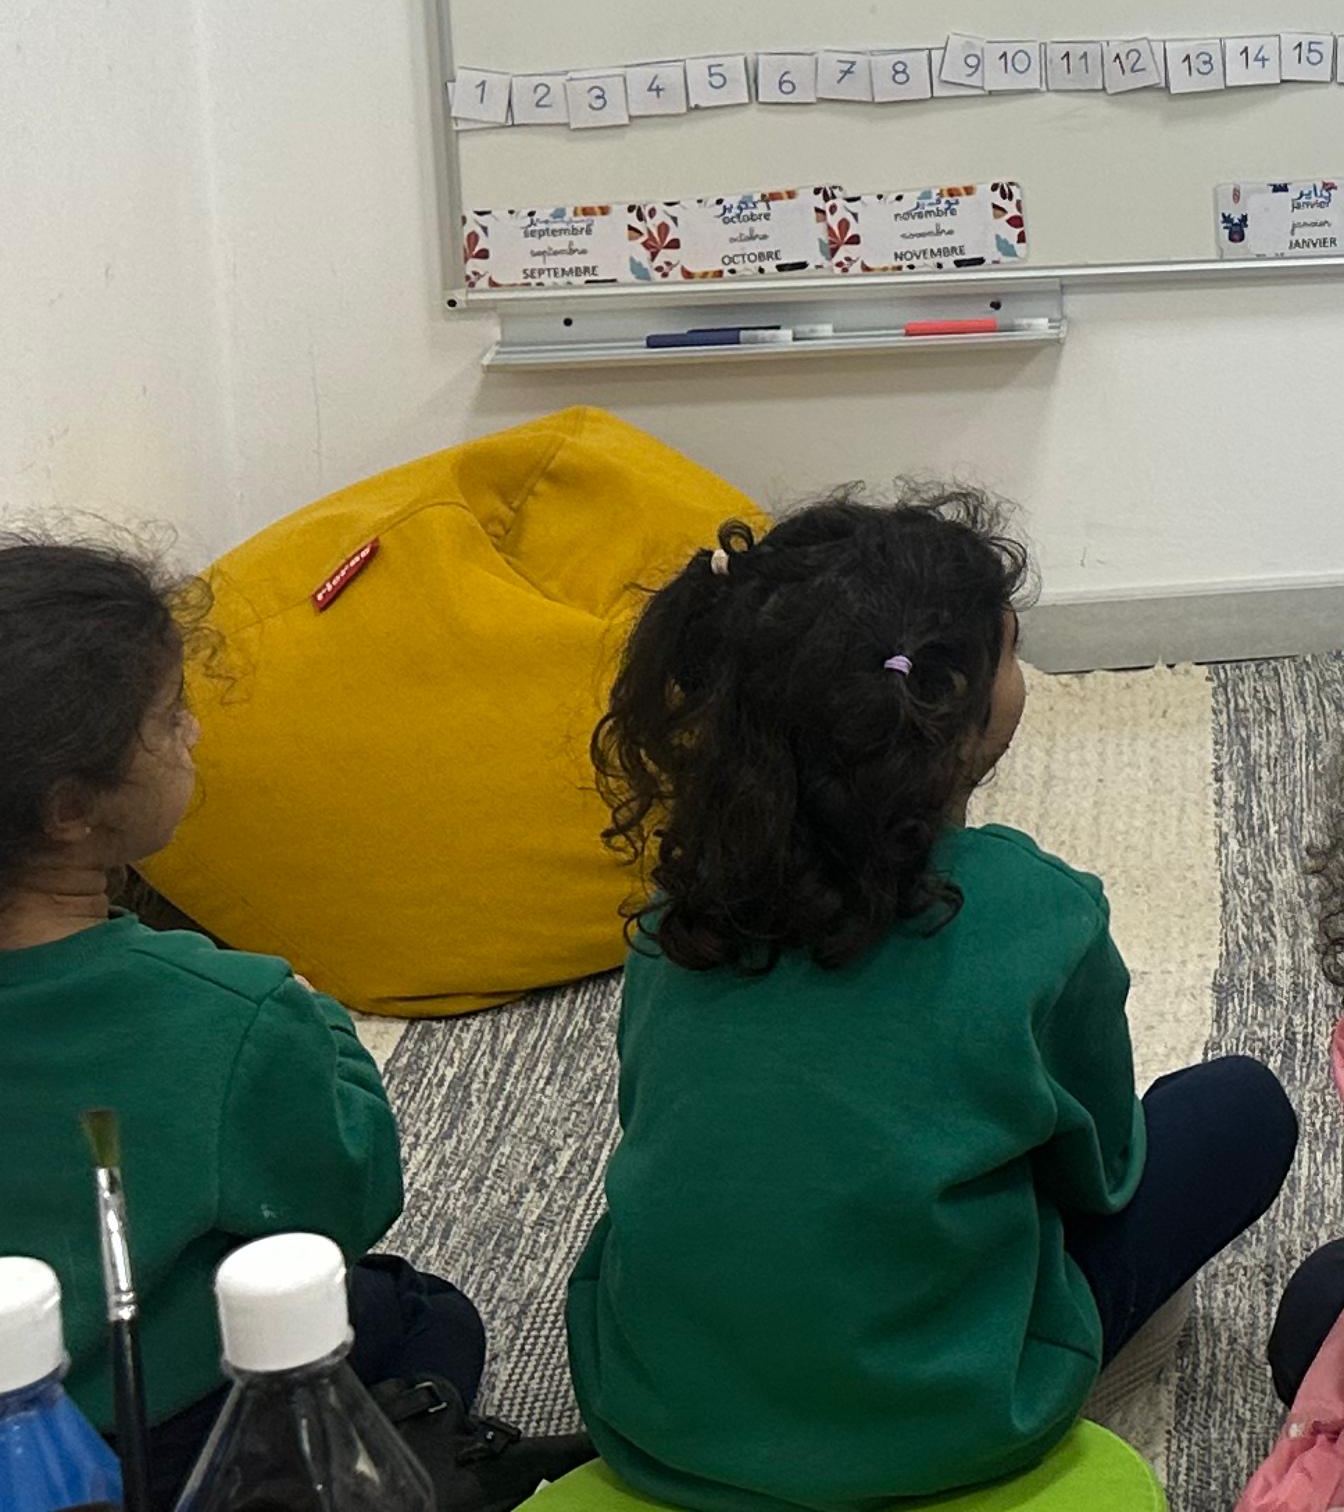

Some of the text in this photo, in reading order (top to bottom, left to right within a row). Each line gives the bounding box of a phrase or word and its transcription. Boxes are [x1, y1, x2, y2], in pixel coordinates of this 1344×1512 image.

[476, 79, 487, 103] 1
[532, 83, 553, 109] 2
[587, 86, 608, 112] 3
[646, 74, 666, 99] 4
[707, 62, 728, 89] 5
[778, 70, 796, 96] 6
[836, 60, 857, 84] 7
[892, 60, 910, 85] 8
[963, 53, 981, 78] 9
[999, 50, 1031, 75] 10
[1060, 50, 1090, 75] 11
[1112, 48, 1146, 77] 12
[1181, 51, 1214, 77] 13
[1239, 46, 1270, 70] 14
[1292, 41, 1324, 66] 15
[1289, 236, 1337, 249] JANVIER
[721, 250, 782, 265] OCTOBRE
[894, 245, 966, 262] NOVEMBRE
[522, 265, 599, 280] SEPTEMBRE
